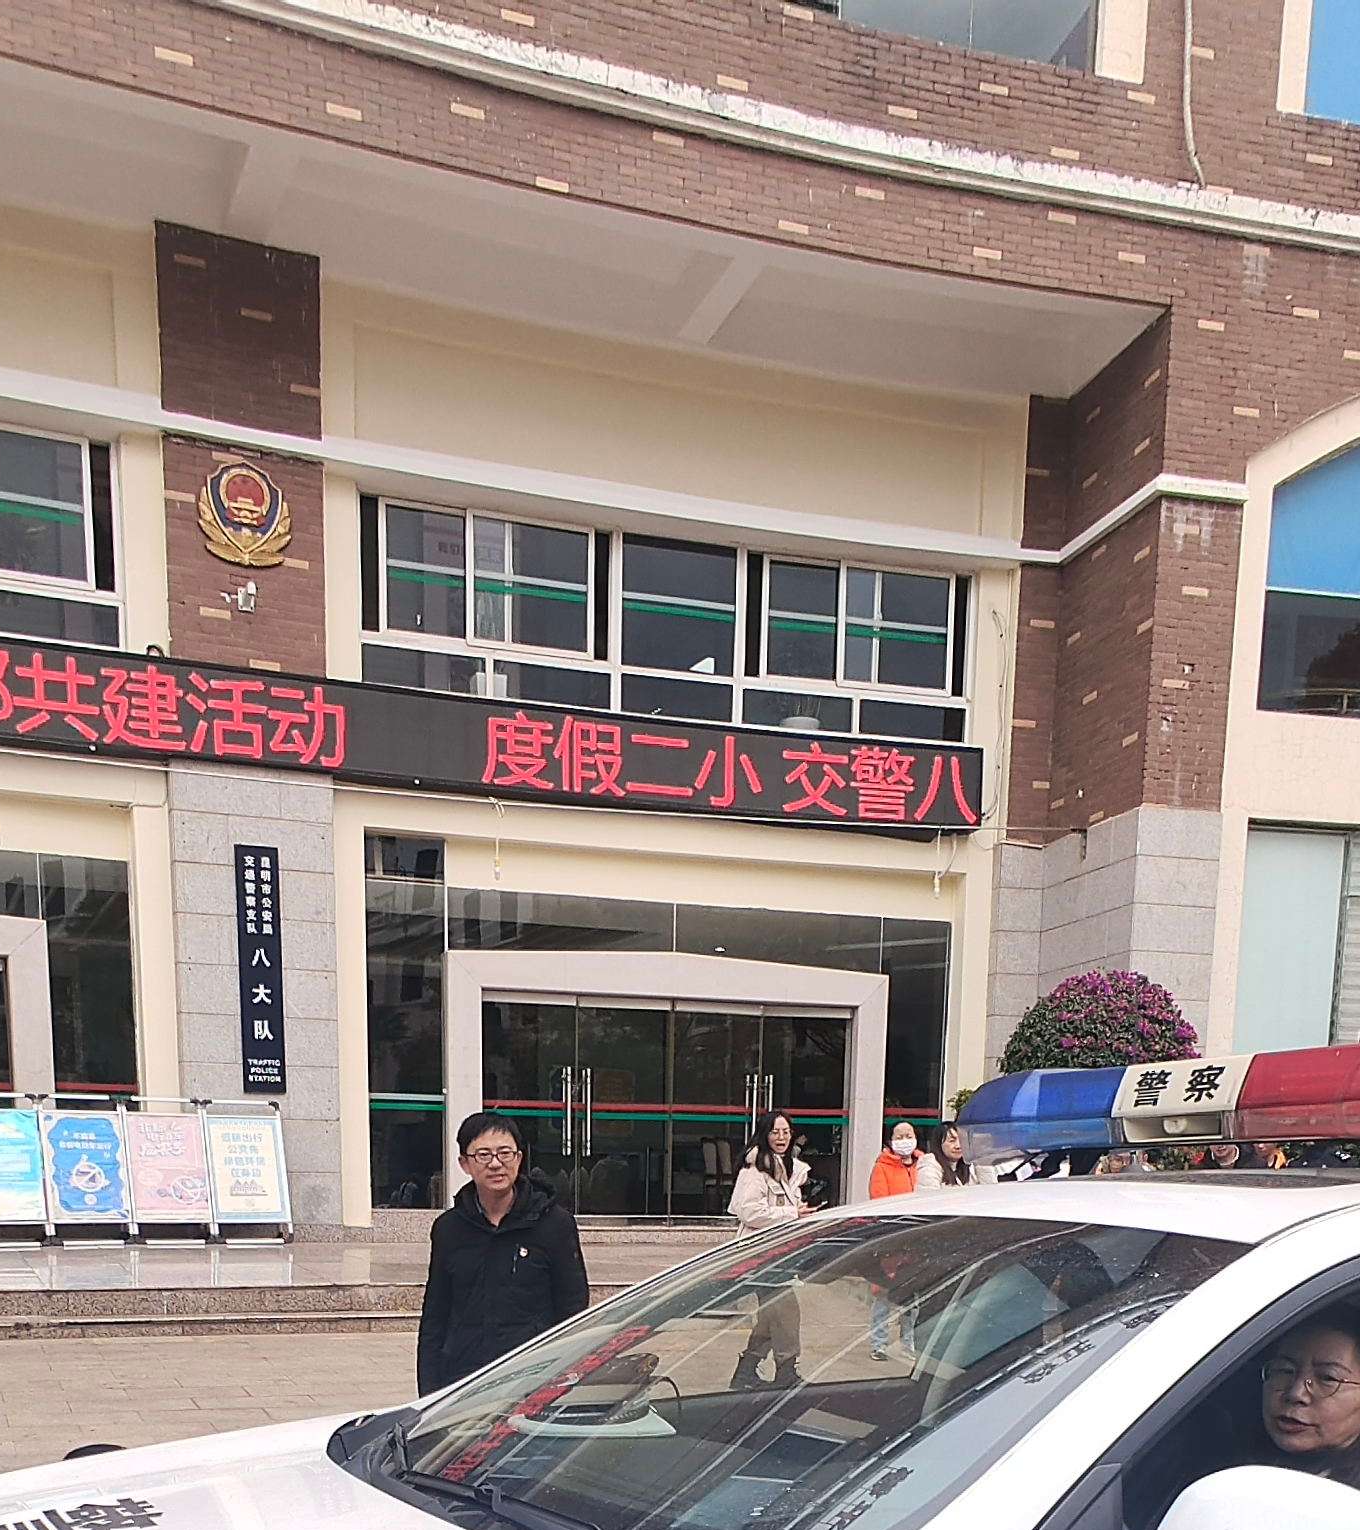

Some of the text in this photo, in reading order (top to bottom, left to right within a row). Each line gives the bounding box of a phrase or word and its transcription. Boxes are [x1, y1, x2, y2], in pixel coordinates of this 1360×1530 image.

[482, 711, 764, 811] 度假二小
[782, 744, 979, 827] 交警八
[251, 948, 274, 1041] 八大队
[1133, 1064, 1226, 1108] 警察
